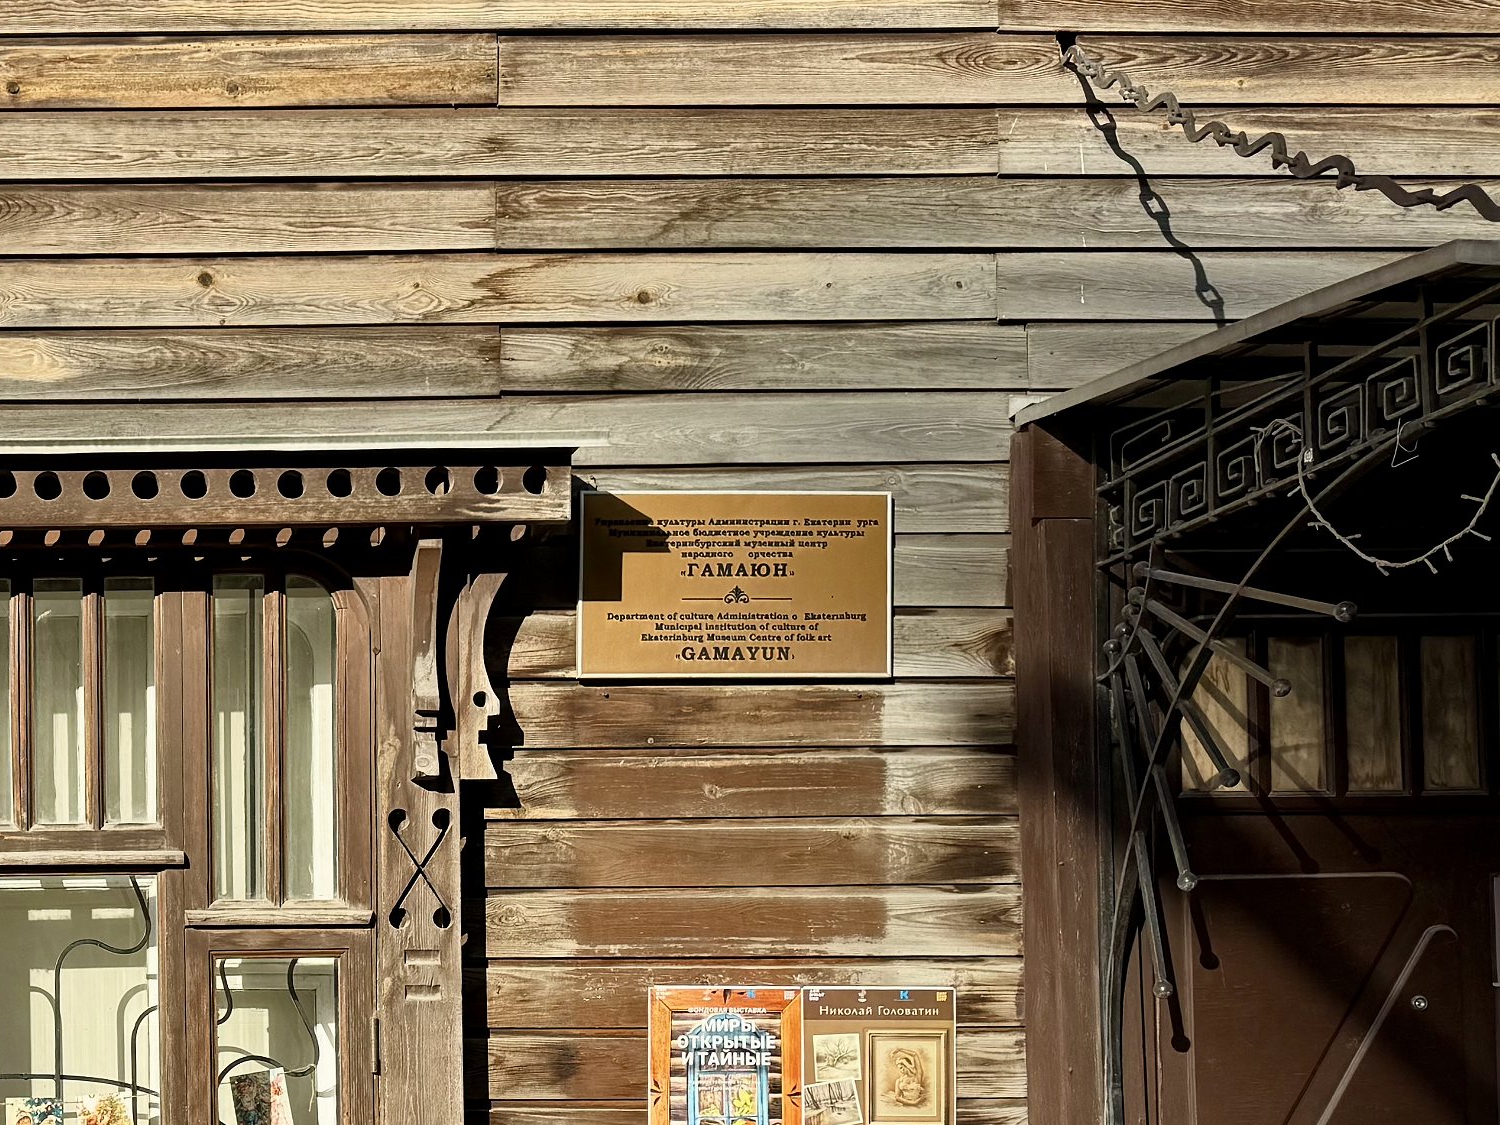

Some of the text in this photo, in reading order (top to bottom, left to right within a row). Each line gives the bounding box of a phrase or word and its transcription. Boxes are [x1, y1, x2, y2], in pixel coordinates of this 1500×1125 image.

[657, 519, 705, 527] культуры
[708, 518, 790, 527] Администрации
[693, 529, 750, 537] бюджетное
[753, 529, 813, 538] учреждение
[817, 529, 865, 537] культуры
[744, 539, 795, 548] музейный
[798, 541, 828, 549] центр
[681, 551, 733, 559] народного
[607, 612, 665, 622] Department
[667, 612, 678, 620] of
[679, 612, 714, 620] culture
[717, 612, 789, 620] Administration
[804, 612, 867, 621] Ekaterinburg
[655, 623, 819, 632] Municipal institution of culture of
[641, 634, 703, 642] Ekaterinburg
[819, 1005, 939, 1016] Николай Головатин
[701, 1019, 756, 1032] МИРЫ
[677, 1035, 776, 1049] ОТКРЫТЫЕ
[681, 1049, 772, 1066] И ТАЙНЫЕ
